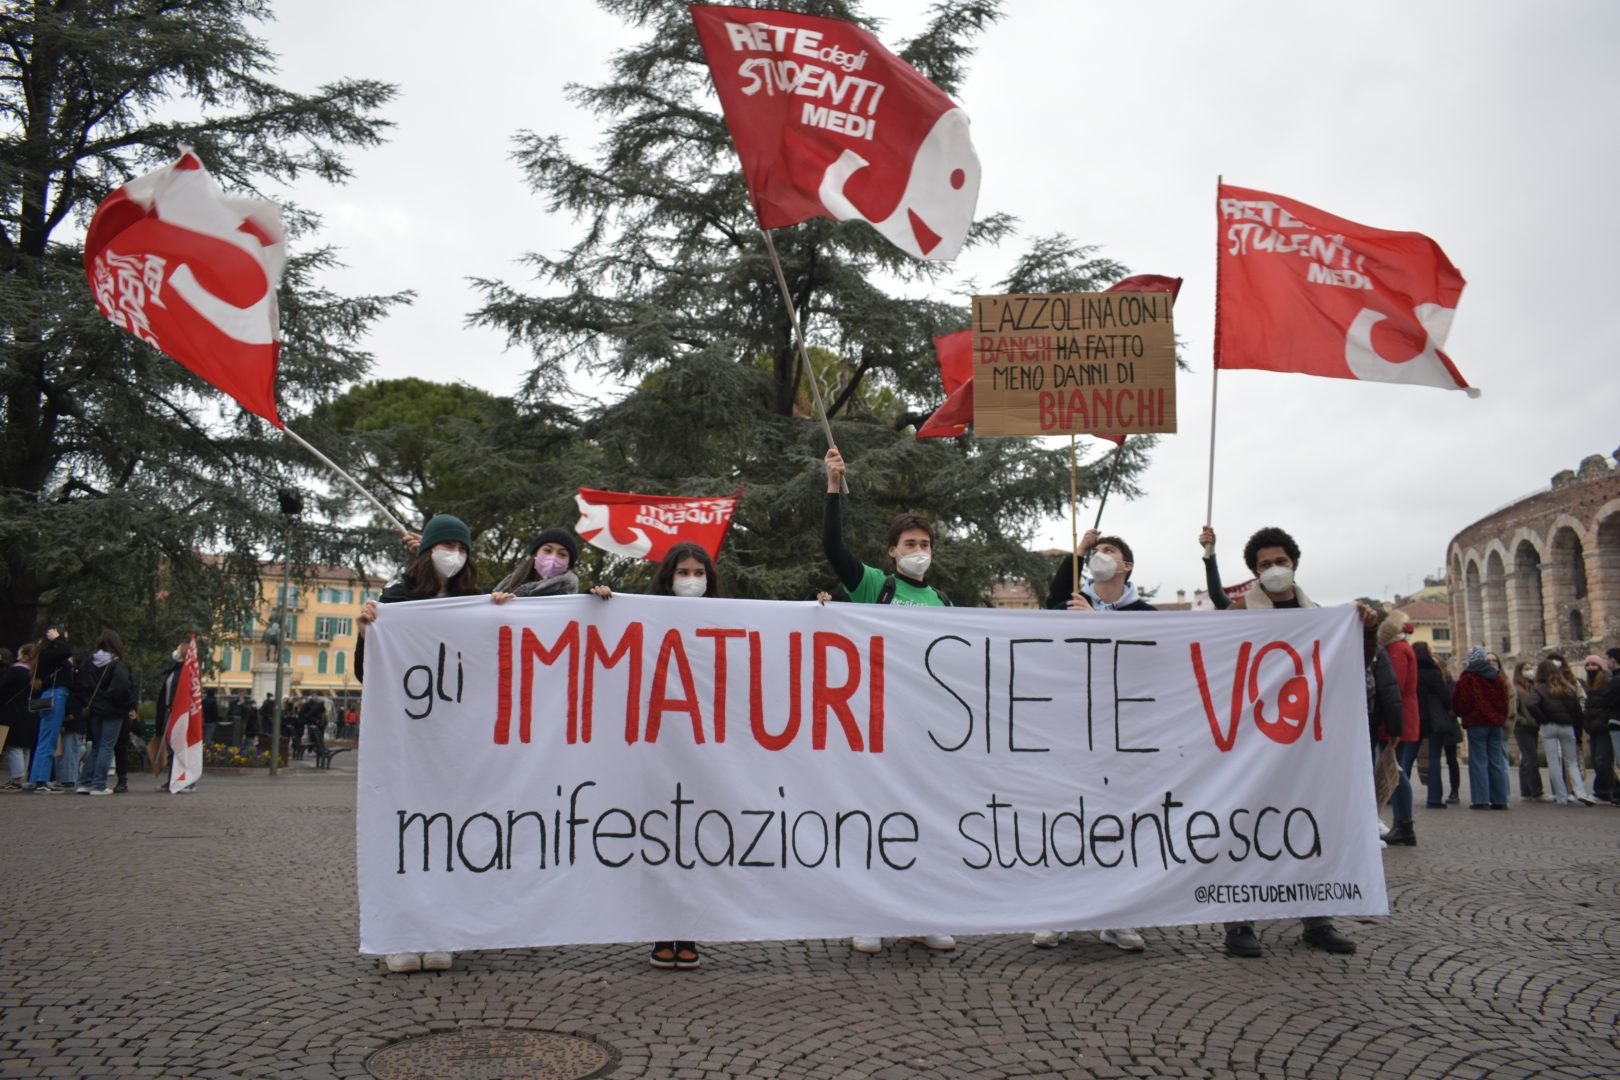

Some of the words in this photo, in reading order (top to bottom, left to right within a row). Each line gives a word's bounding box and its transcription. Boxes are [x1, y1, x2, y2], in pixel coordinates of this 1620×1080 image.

[725, 22, 823, 58] RETE
[820, 45, 868, 72] degli
[738, 58, 885, 116] STUDENTI
[801, 102, 875, 140] MEDI
[978, 296, 1117, 333] L'AZZOLINA
[1118, 296, 1157, 327] CON
[1163, 297, 1170, 324] I
[980, 336, 1051, 364] BANCHI
[1056, 336, 1081, 360] HA
[1085, 334, 1144, 360] FATTO
[993, 365, 1045, 391] MENO
[1053, 363, 1108, 389] DANNI
[1117, 362, 1135, 384] DI
[1039, 387, 1164, 431] BIANCHI
[403, 642, 464, 720] gli
[493, 620, 885, 753] IMMATURI
[924, 635, 1160, 754] SIETE
[1190, 639, 1323, 752] VOI
[397, 781, 918, 874] manifestazione
[958, 790, 1322, 871] studentesca
[1194, 883, 1363, 904] @RETESTUDENTIVERONA
